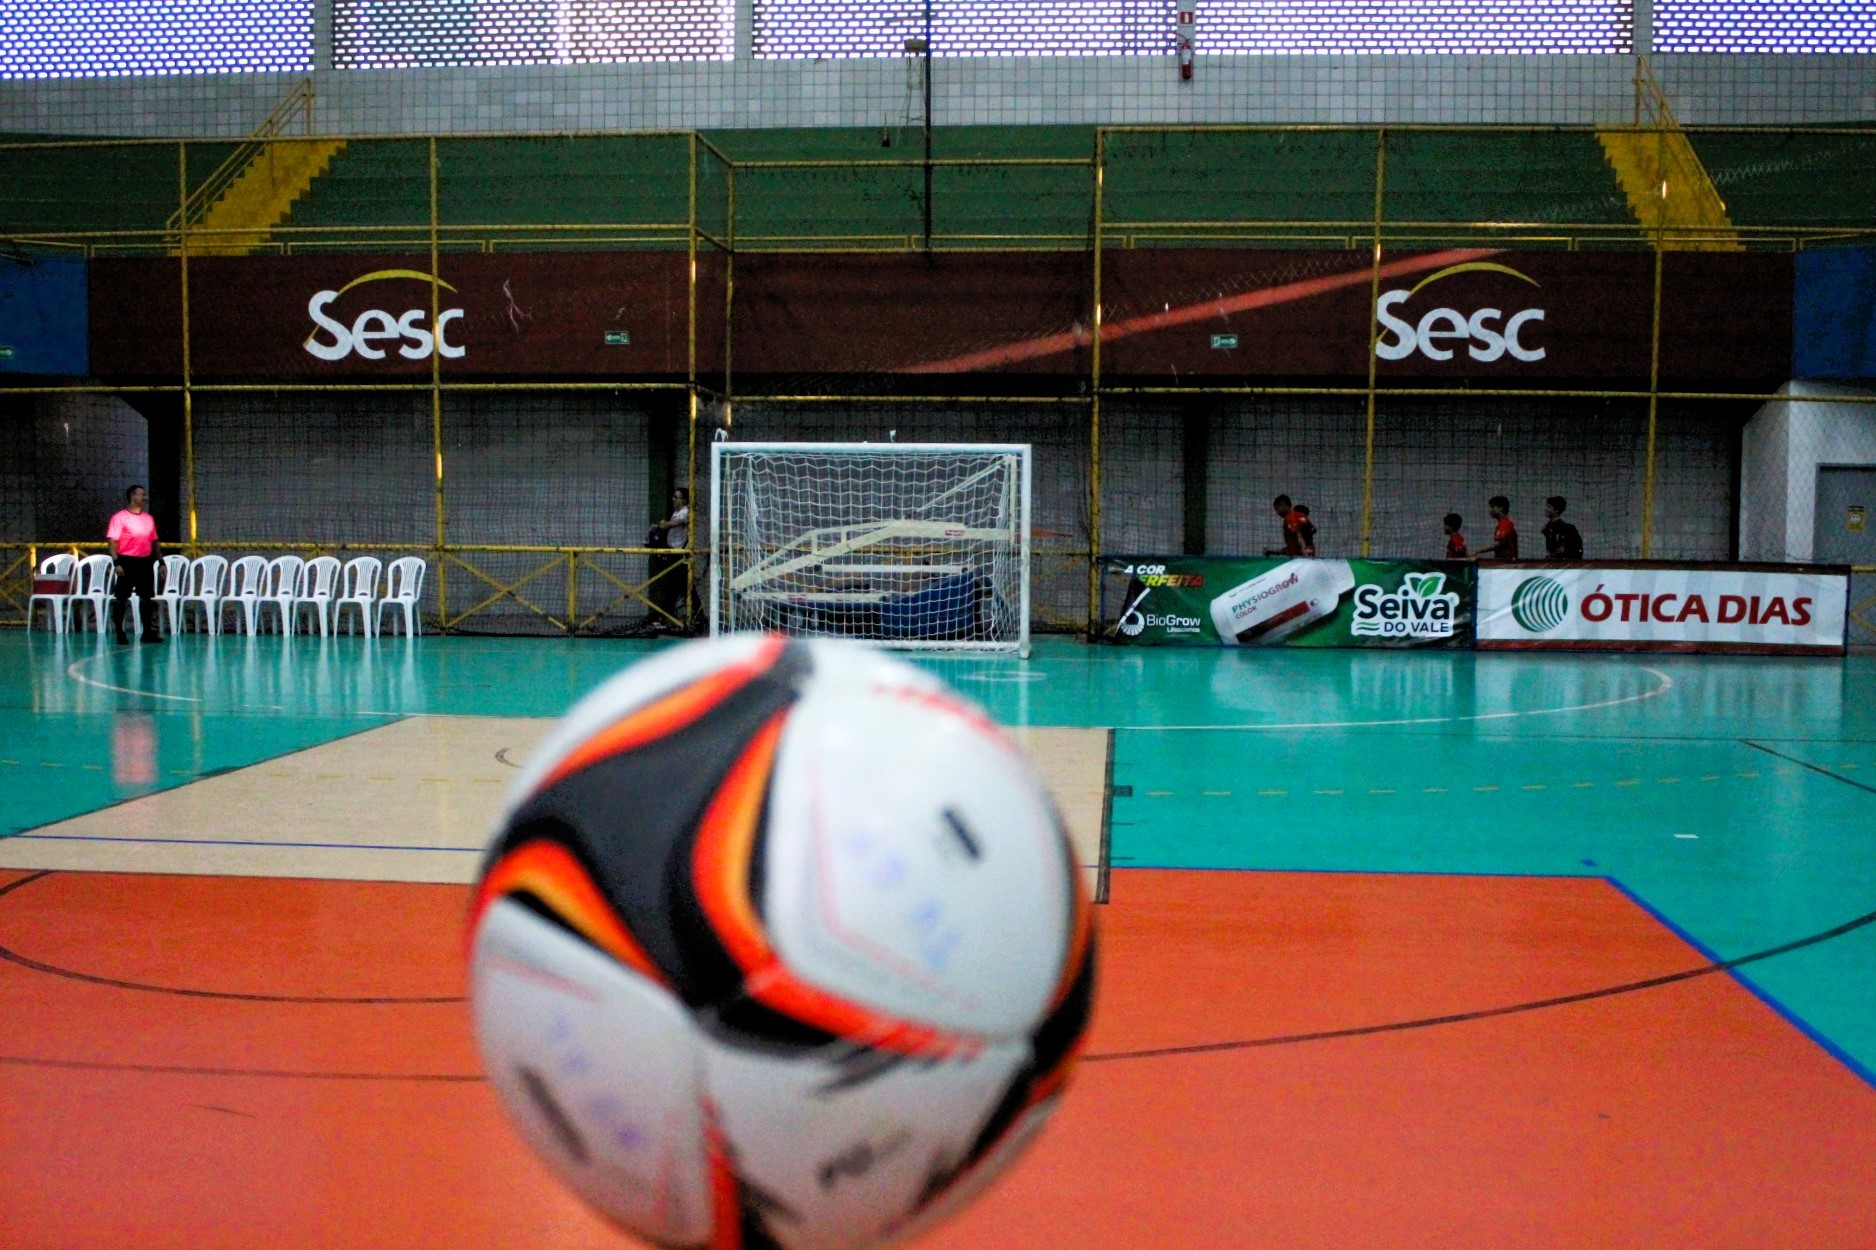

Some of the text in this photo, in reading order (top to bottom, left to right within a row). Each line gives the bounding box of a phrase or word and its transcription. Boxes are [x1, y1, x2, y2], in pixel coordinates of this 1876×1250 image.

[303, 290, 466, 361] Sesc
[1375, 289, 1546, 362] Sesc
[1137, 565, 1165, 574] COR
[1139, 574, 1203, 587] ERFEITA
[1358, 588, 1450, 619] Seiva
[1580, 584, 1813, 626] ÓTICA DIAS
[1235, 605, 1257, 619] COLOR
[1146, 614, 1201, 626] BioGrow
[1384, 621, 1449, 632] DO VALE
